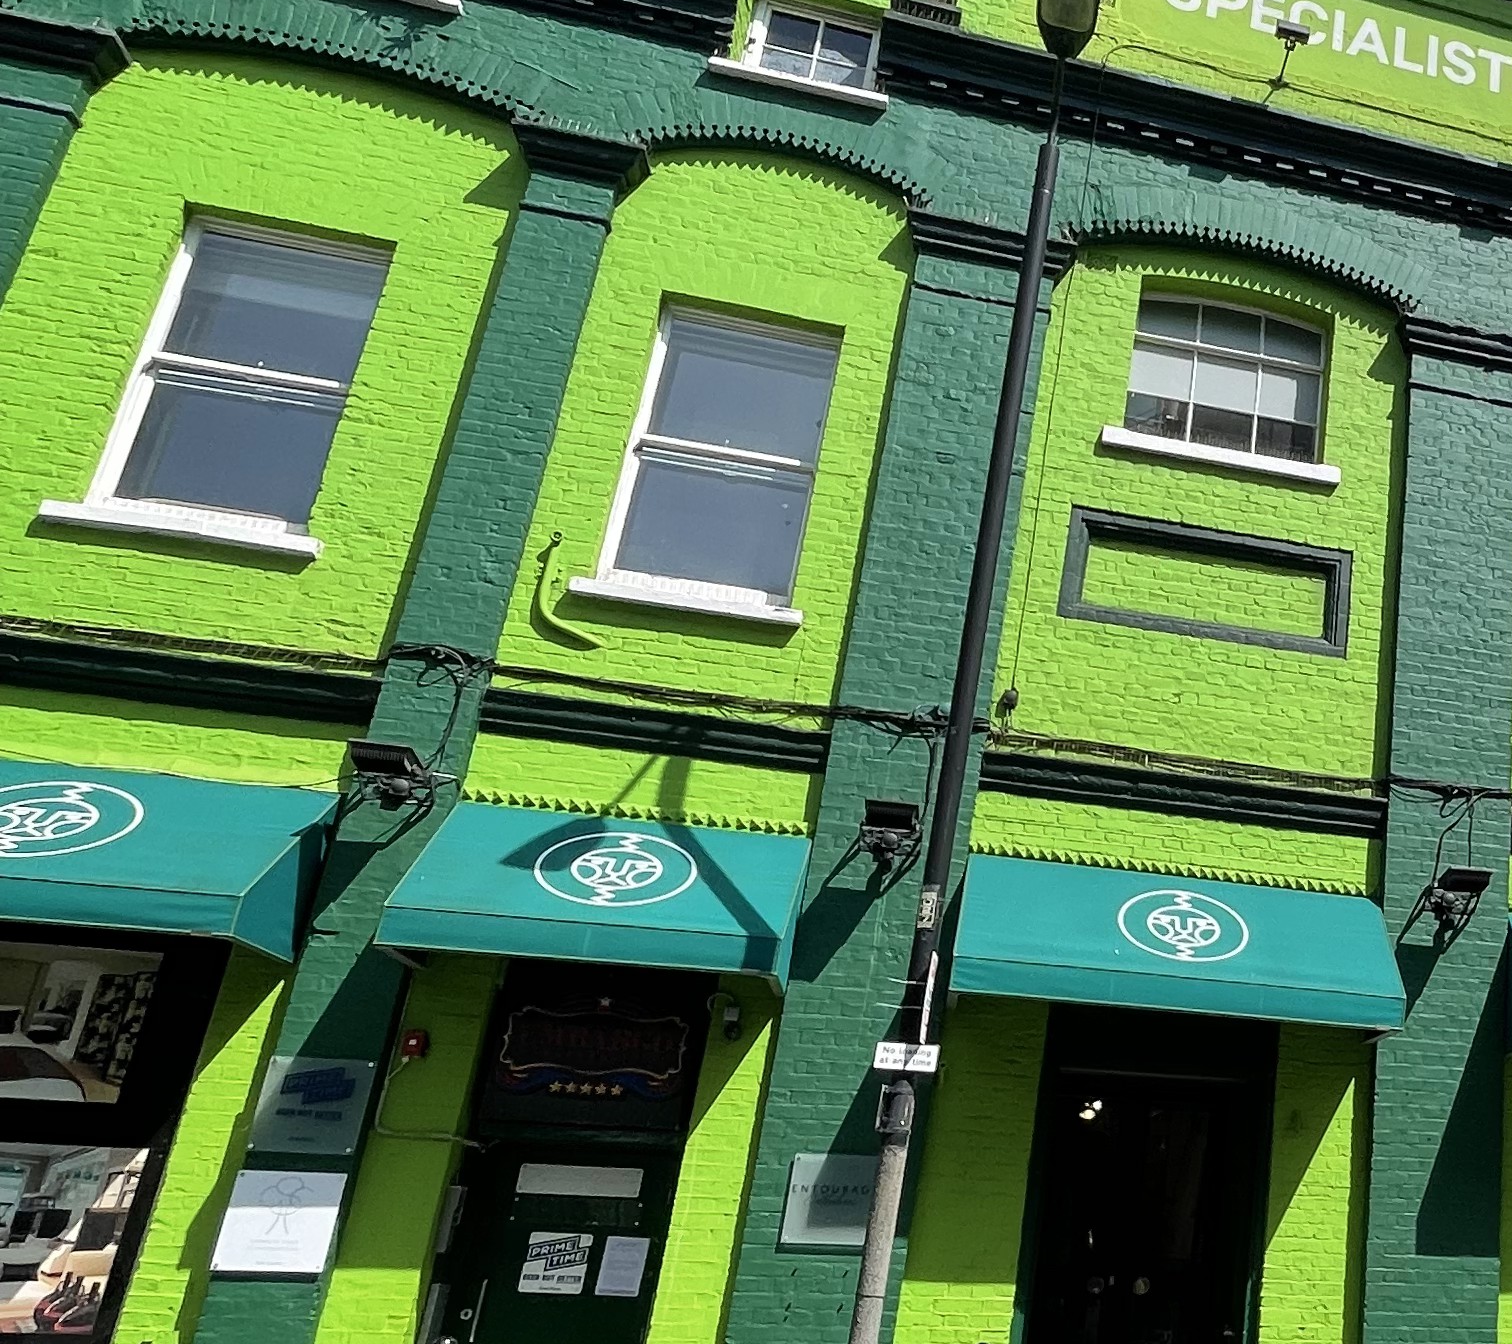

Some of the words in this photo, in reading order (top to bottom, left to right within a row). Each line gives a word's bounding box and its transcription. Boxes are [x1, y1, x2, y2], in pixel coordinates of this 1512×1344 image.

[882, 1046, 896, 1054] No
[899, 1047, 932, 1059] loading
[912, 1059, 932, 1067] time
[792, 1184, 870, 1195] ENTOURAG
[531, 1240, 576, 1257] PRIME
[552, 1251, 584, 1266] TIME
